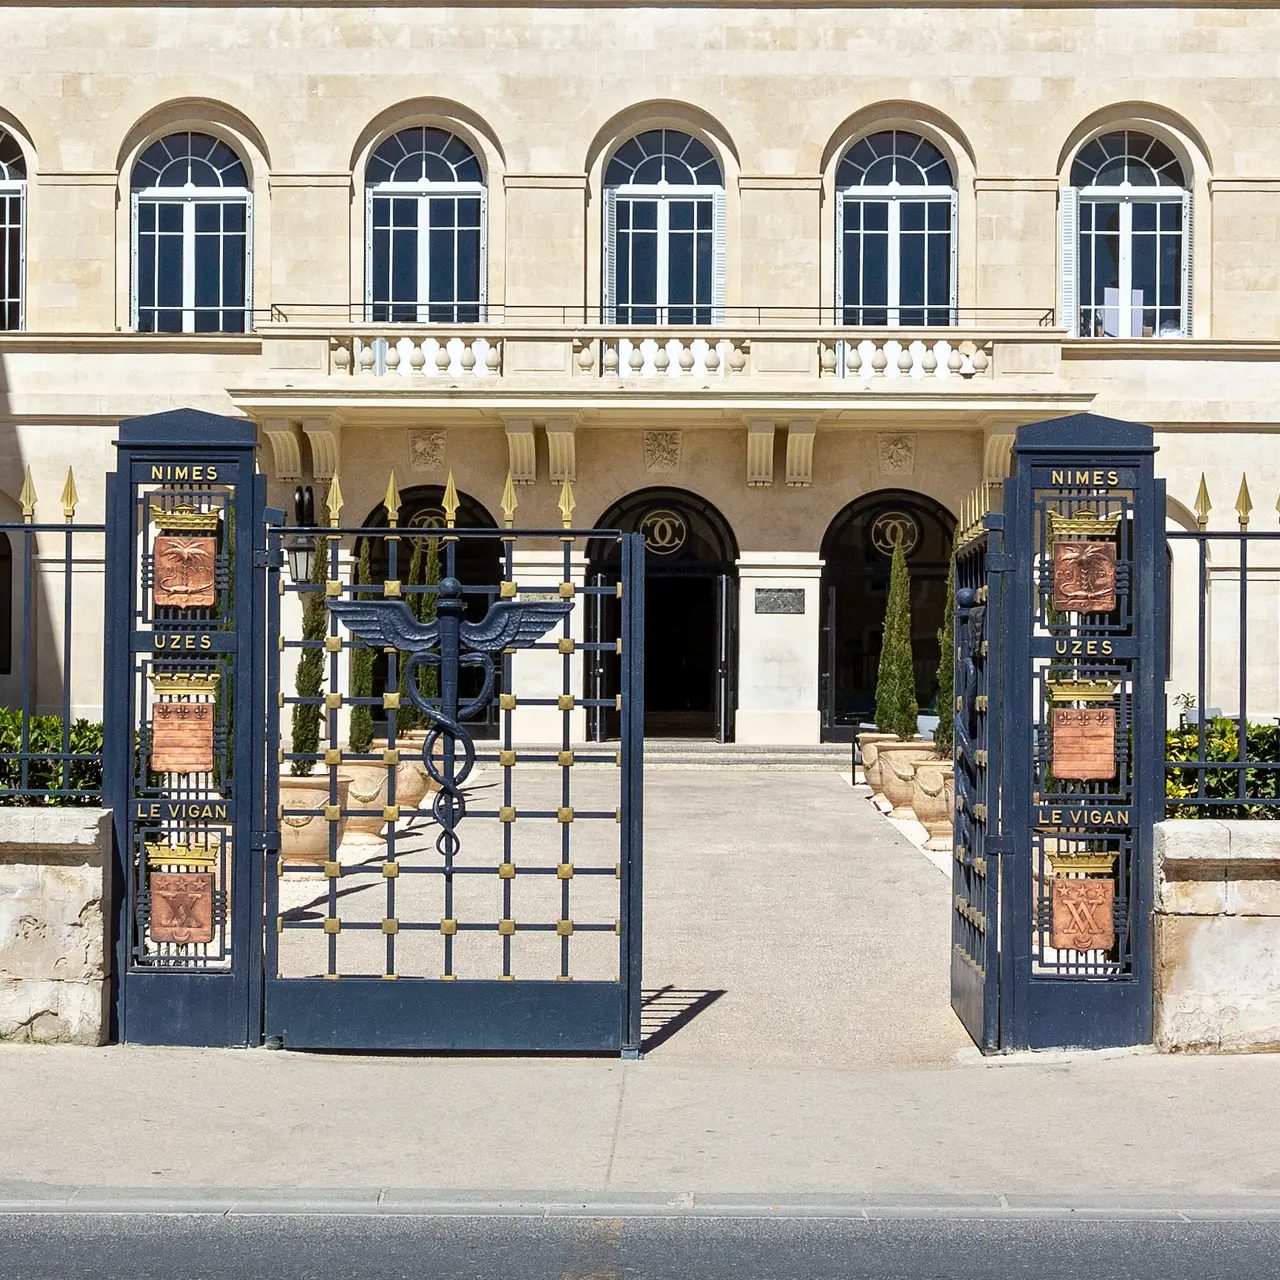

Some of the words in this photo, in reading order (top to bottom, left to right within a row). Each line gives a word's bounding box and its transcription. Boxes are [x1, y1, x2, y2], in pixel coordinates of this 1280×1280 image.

[151, 465, 218, 481] NIMES
[1052, 470, 1119, 486] NIMES
[154, 634, 212, 650] UZES
[1055, 640, 1113, 655] UZES
[137, 803, 161, 818] LE
[167, 804, 227, 819] VIGAN
[1038, 809, 1063, 824] LE
[1069, 810, 1129, 825] VIGAN
